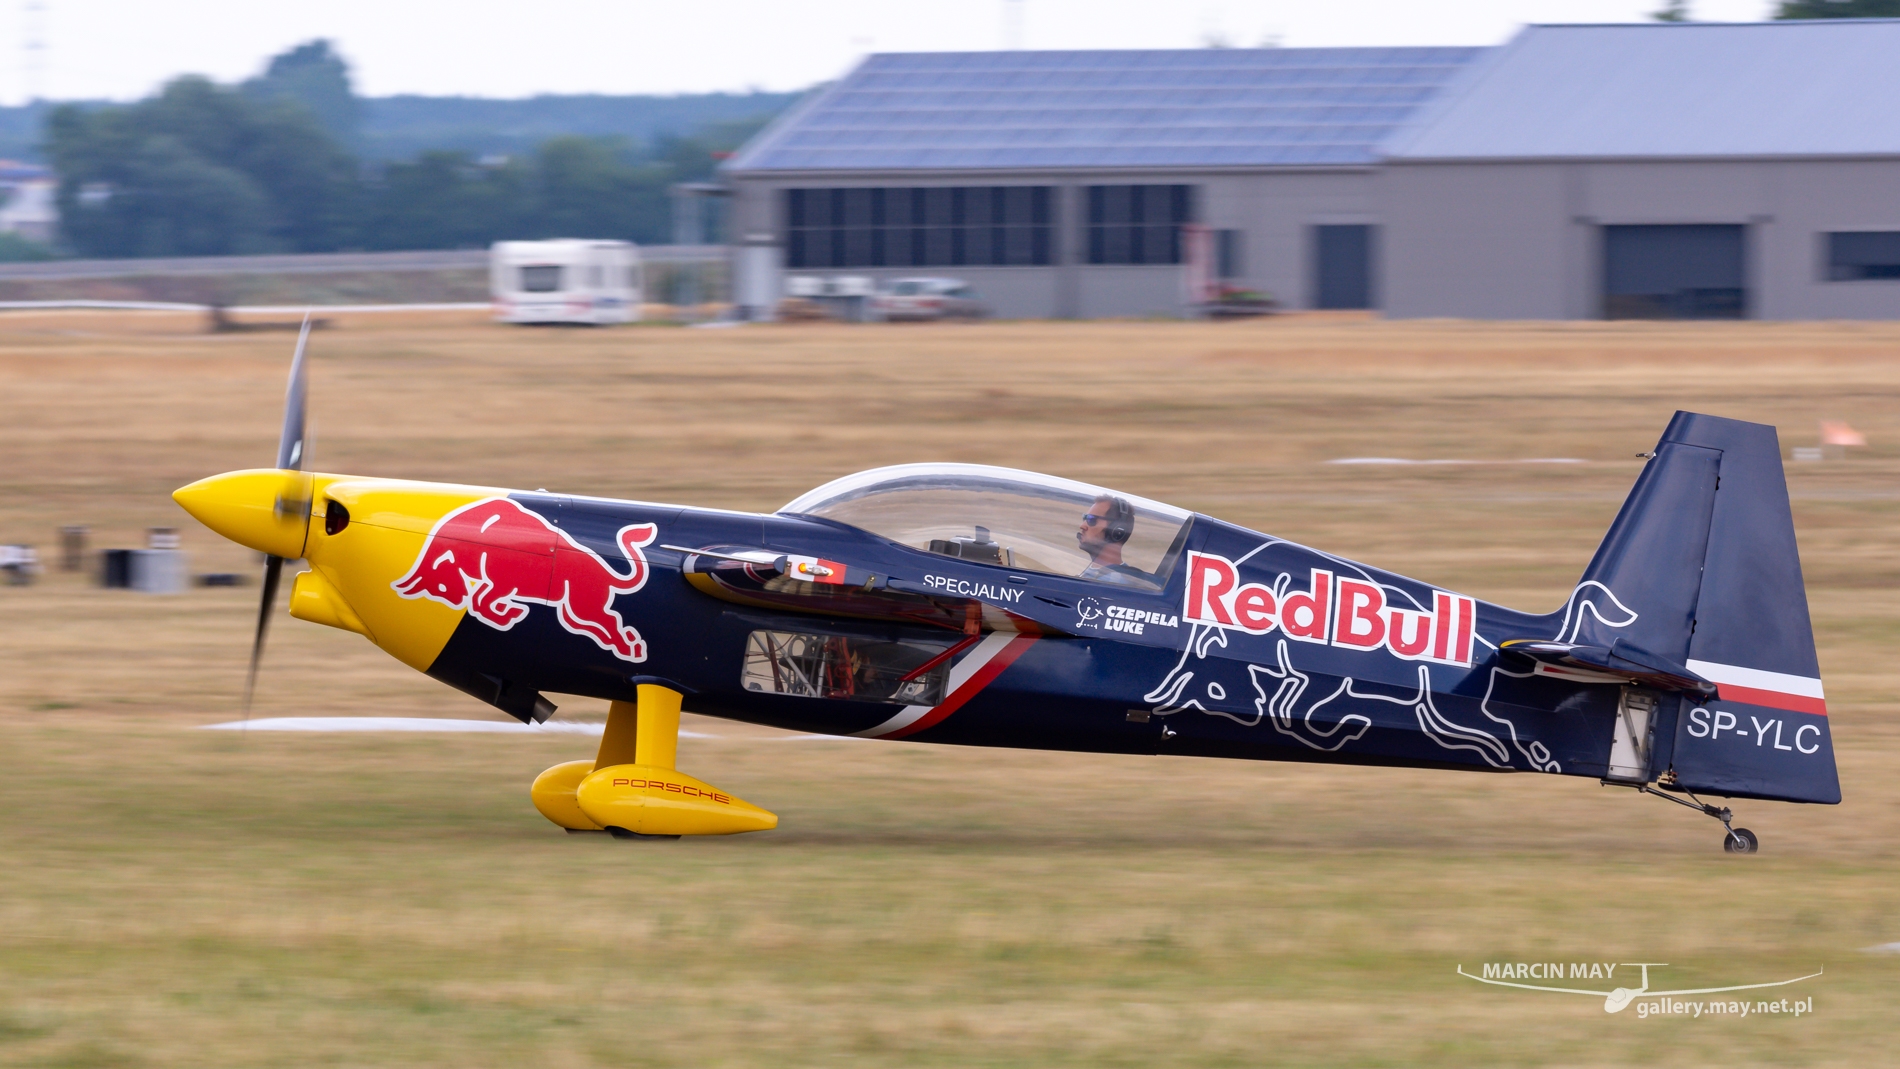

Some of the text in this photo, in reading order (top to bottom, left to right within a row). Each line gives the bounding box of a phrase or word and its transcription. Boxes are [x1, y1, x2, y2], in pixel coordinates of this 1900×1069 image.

[923, 574, 1024, 603] SPECJALNY
[1104, 618, 1145, 635] LUKE
[1106, 605, 1179, 628] CZEPIELA
[1687, 707, 1821, 754] SP-YLC
[613, 778, 730, 805] PORSCHE
